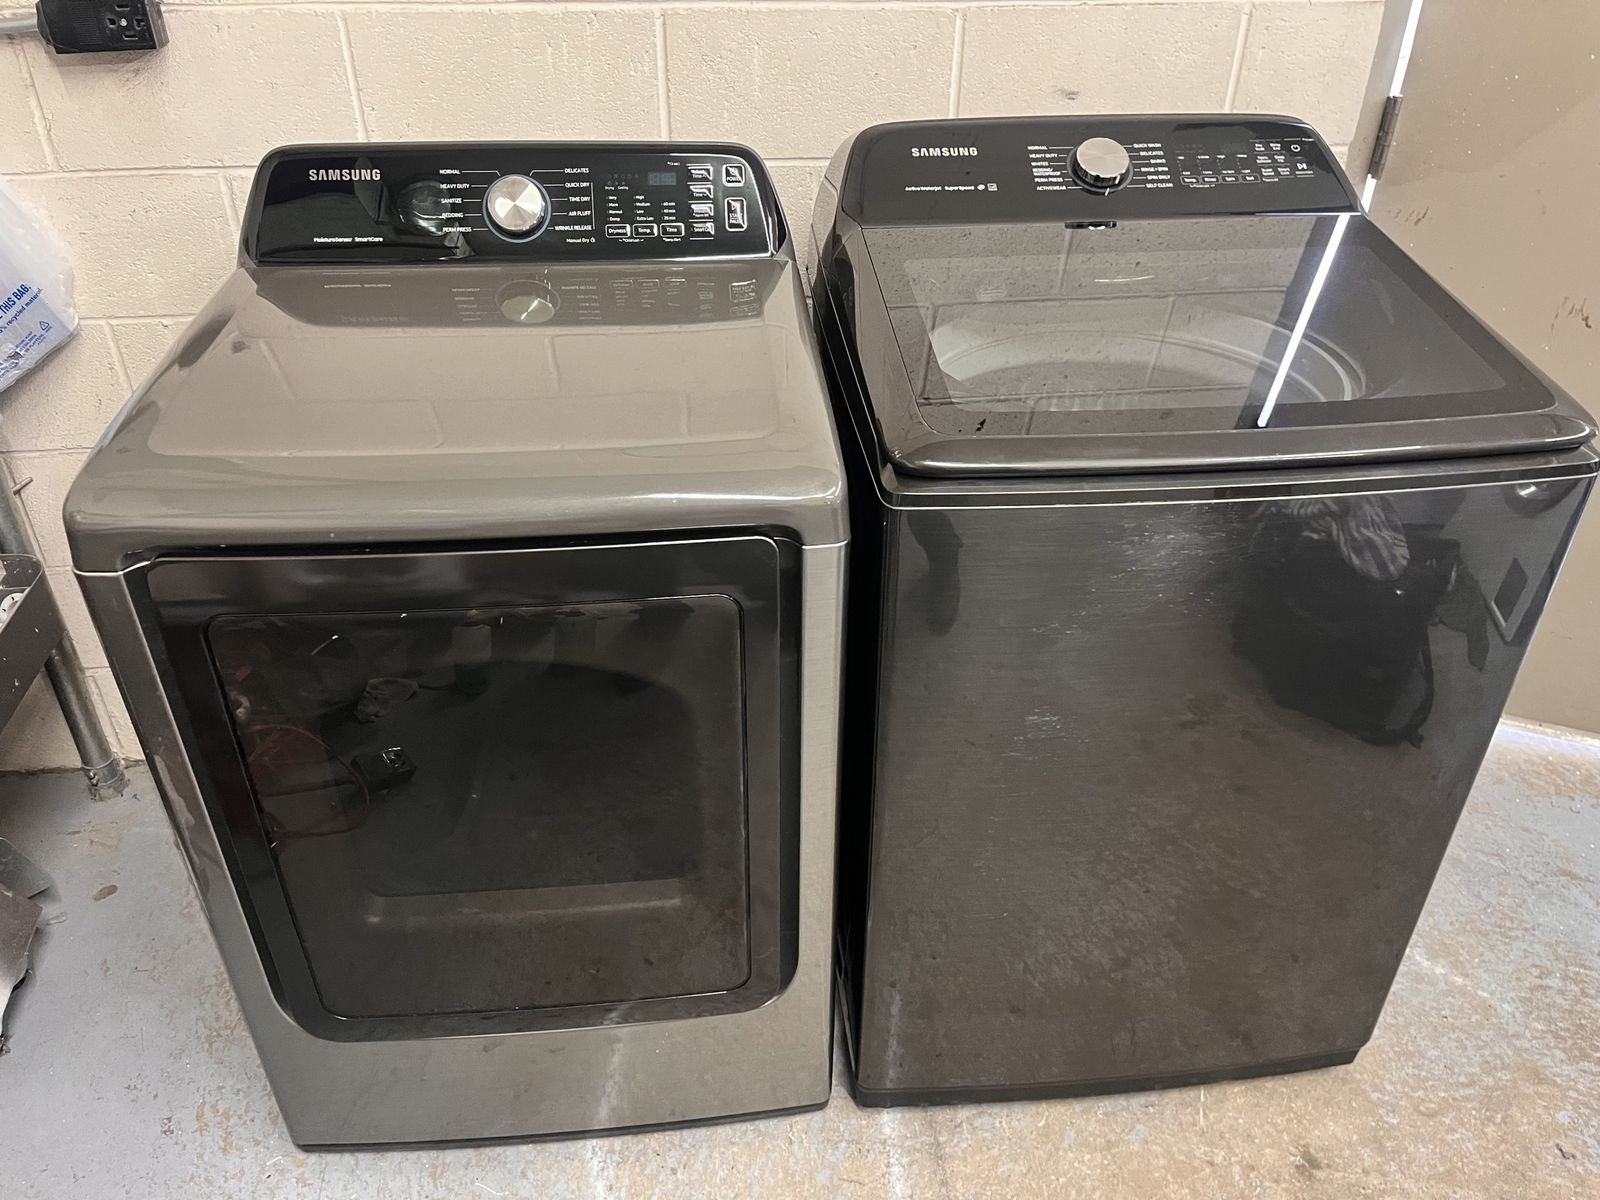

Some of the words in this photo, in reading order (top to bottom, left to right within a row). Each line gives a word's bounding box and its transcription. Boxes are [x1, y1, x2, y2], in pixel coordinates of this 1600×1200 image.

[911, 147, 978, 157] SAMSUNG
[308, 169, 381, 181] SAMSUNG
[0, 297, 16, 315] THIS
[12, 283, 32, 301] BAG.
[7, 306, 26, 326] recycled
